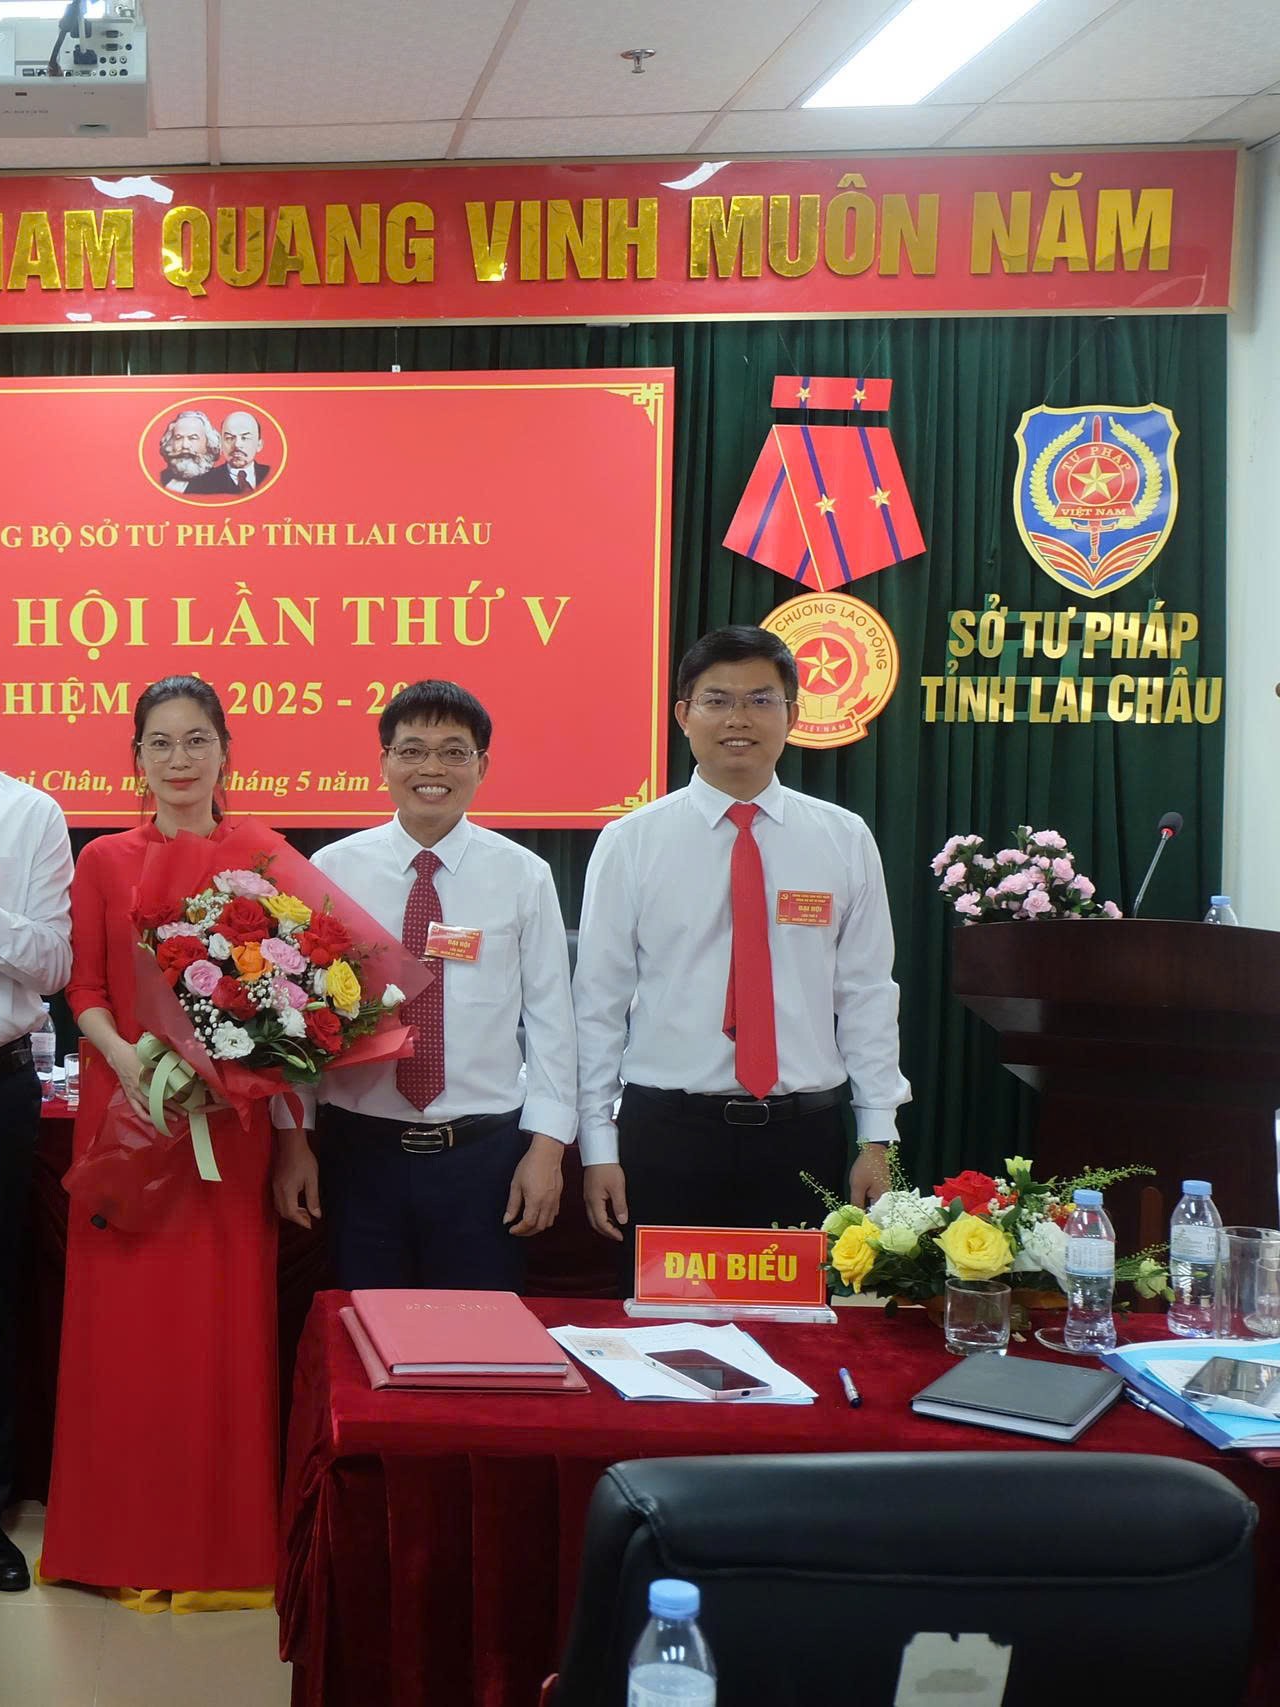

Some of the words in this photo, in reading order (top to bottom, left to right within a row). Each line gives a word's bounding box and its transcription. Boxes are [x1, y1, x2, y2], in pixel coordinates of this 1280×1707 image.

[161, 201, 435, 297] QUANG
[464, 196, 659, 283] VINH
[689, 173, 940, 278] MUÔN
[970, 172, 1175, 275] NĂM
[30, 522, 72, 554] BỘ
[79, 518, 120, 548] SỞ
[125, 521, 170, 547] TƯ
[176, 518, 256, 547] PHÁP
[262, 516, 337, 546] TỈNH
[345, 523, 397, 546] LAI
[405, 516, 492, 545] CHÂU
[12, 588, 149, 660] HỘI
[171, 581, 320, 647] LẦN
[342, 580, 505, 647] THỨ
[521, 596, 571, 647] V
[840, 606, 867, 627] LAO
[865, 627, 887, 670] ĐỘNG
[948, 593, 1009, 658] SỞ
[1019, 606, 1077, 659] TƯ
[1082, 600, 1199, 659] PHÁP
[227, 681, 323, 714] 2025
[920, 659, 1017, 723] TỈNH
[1029, 676, 1094, 723] LAI
[1107, 666, 1223, 724] CHÂU
[42, 770, 113, 794] Châu,
[296, 770, 312, 792] 5
[317, 770, 370, 792] năm
[664, 1252, 716, 1285] ĐẠI
[727, 1243, 797, 1282] BIỂU
